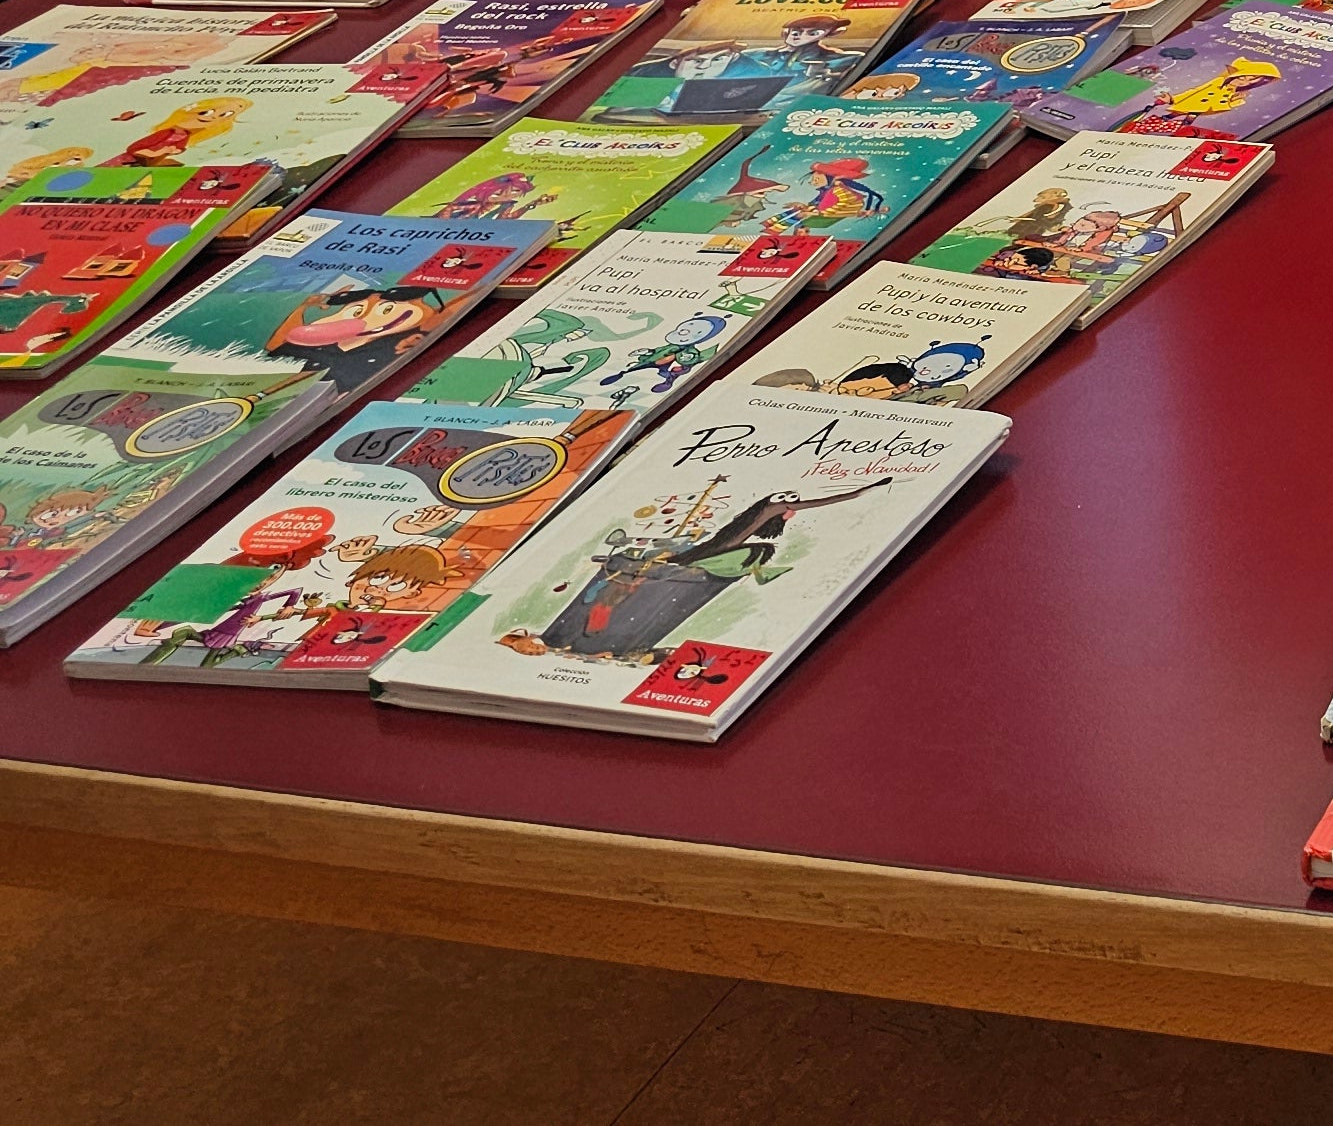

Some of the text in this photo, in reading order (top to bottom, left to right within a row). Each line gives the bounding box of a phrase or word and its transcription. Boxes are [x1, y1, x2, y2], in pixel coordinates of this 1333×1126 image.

[347, 223, 495, 243] Los caprichos
[326, 238, 411, 256] de Rasi
[597, 267, 644, 280] Pupi
[579, 283, 710, 300] va al hospital
[877, 284, 1028, 314] Pupi y la aventura
[857, 299, 996, 329] de los cowboys
[748, 398, 953, 428] Colas Gutman Marc Boutavant
[672, 419, 952, 467] Perro Apestoso
[324, 477, 408, 491] El caso del
[286, 487, 418, 504] librero misterioso
[536, 672, 592, 685] HUESITOS
[638, 689, 711, 709] Aventuras
